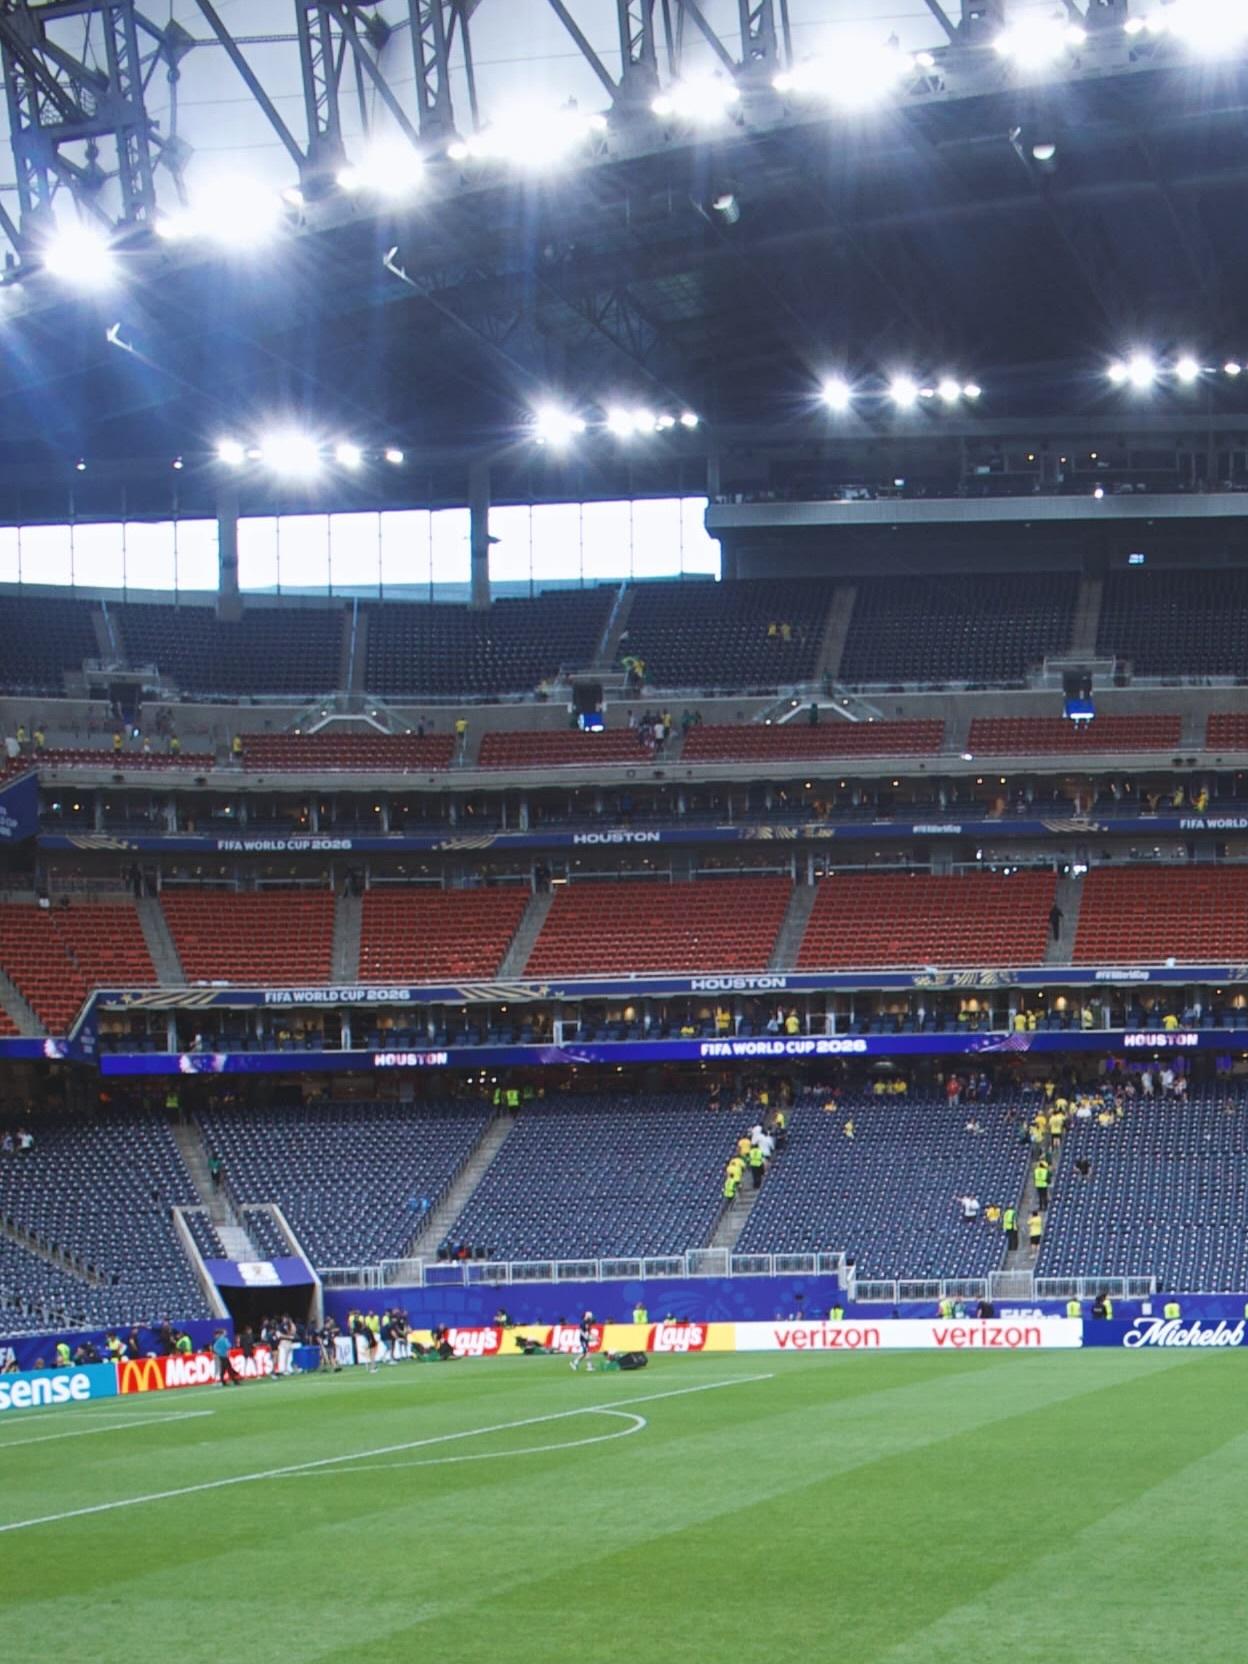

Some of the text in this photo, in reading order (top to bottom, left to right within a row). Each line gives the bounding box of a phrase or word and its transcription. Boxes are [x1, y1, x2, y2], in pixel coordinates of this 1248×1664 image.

[1180, 819, 1205, 829] FIFA
[1206, 819, 1248, 829] WORLD
[218, 839, 352, 851] FIFA WORLD CUP 2026
[573, 832, 661, 844] HOUSTON
[691, 978, 787, 990] HOUSTON
[265, 989, 411, 1003] FIFA WORLD CUP 2026
[1124, 1033, 1199, 1047] HOUSTON
[701, 1039, 867, 1057] FIFA WORLD CUP 2026
[374, 1052, 449, 1066] HOUSTON
[773, 1321, 881, 1349] verizon
[932, 1320, 1042, 1348] verizon
[1122, 1317, 1246, 1348] Michelob
